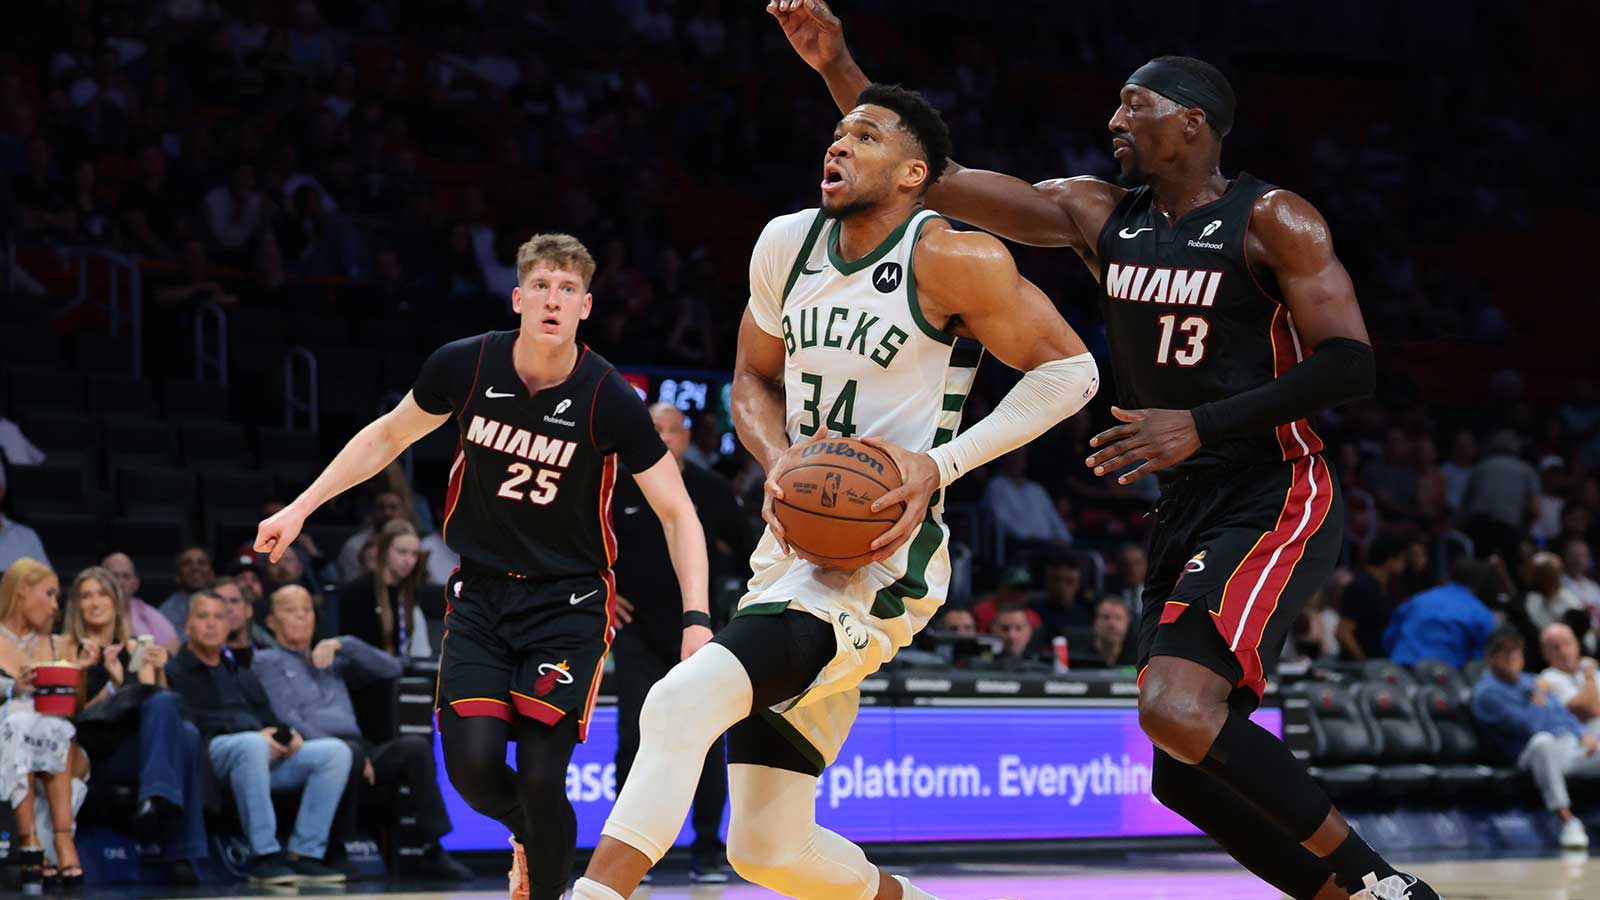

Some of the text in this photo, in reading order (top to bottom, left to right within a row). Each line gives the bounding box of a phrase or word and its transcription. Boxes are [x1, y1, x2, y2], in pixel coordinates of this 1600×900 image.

[1187, 239, 1224, 250] Robinhood
[1106, 262, 1223, 307] MIAMI
[782, 306, 909, 369] BUCKS
[1156, 314, 1210, 366] 13
[543, 415, 576, 428] Robinhood
[800, 372, 858, 438] 34
[465, 414, 579, 469] MIAMI
[801, 442, 885, 476] Wilson
[496, 461, 562, 506] 25
[830, 754, 992, 809] platform.
